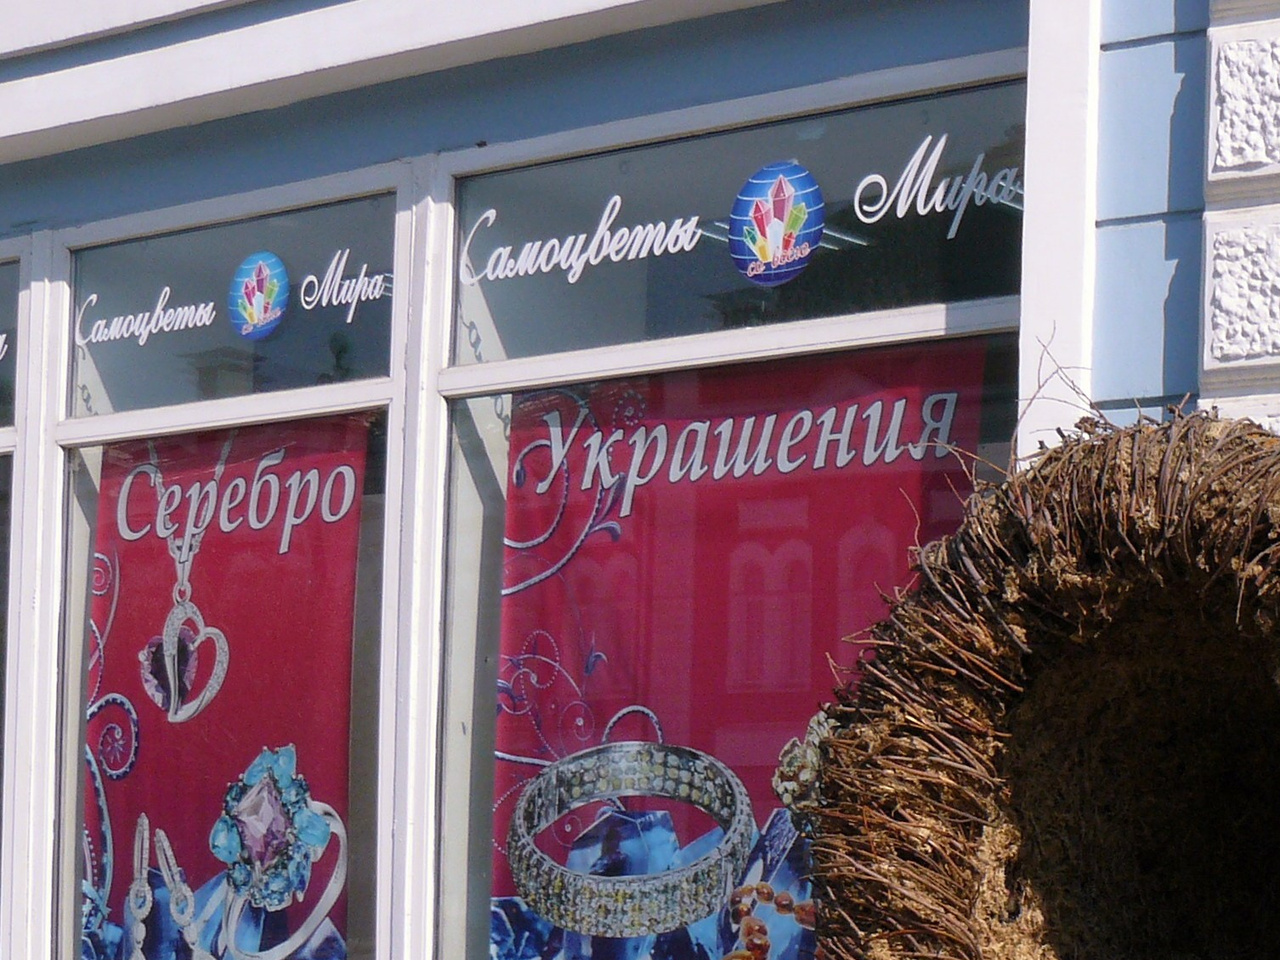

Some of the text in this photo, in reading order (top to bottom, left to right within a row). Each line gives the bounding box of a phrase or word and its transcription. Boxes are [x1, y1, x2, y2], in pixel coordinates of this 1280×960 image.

[459, 133, 1022, 286] Самоцветы Мира
[75, 286, 216, 347] Самоцветы
[300, 248, 385, 323] Мира
[117, 448, 358, 563] Серебро
[535, 390, 960, 518] Украшения
